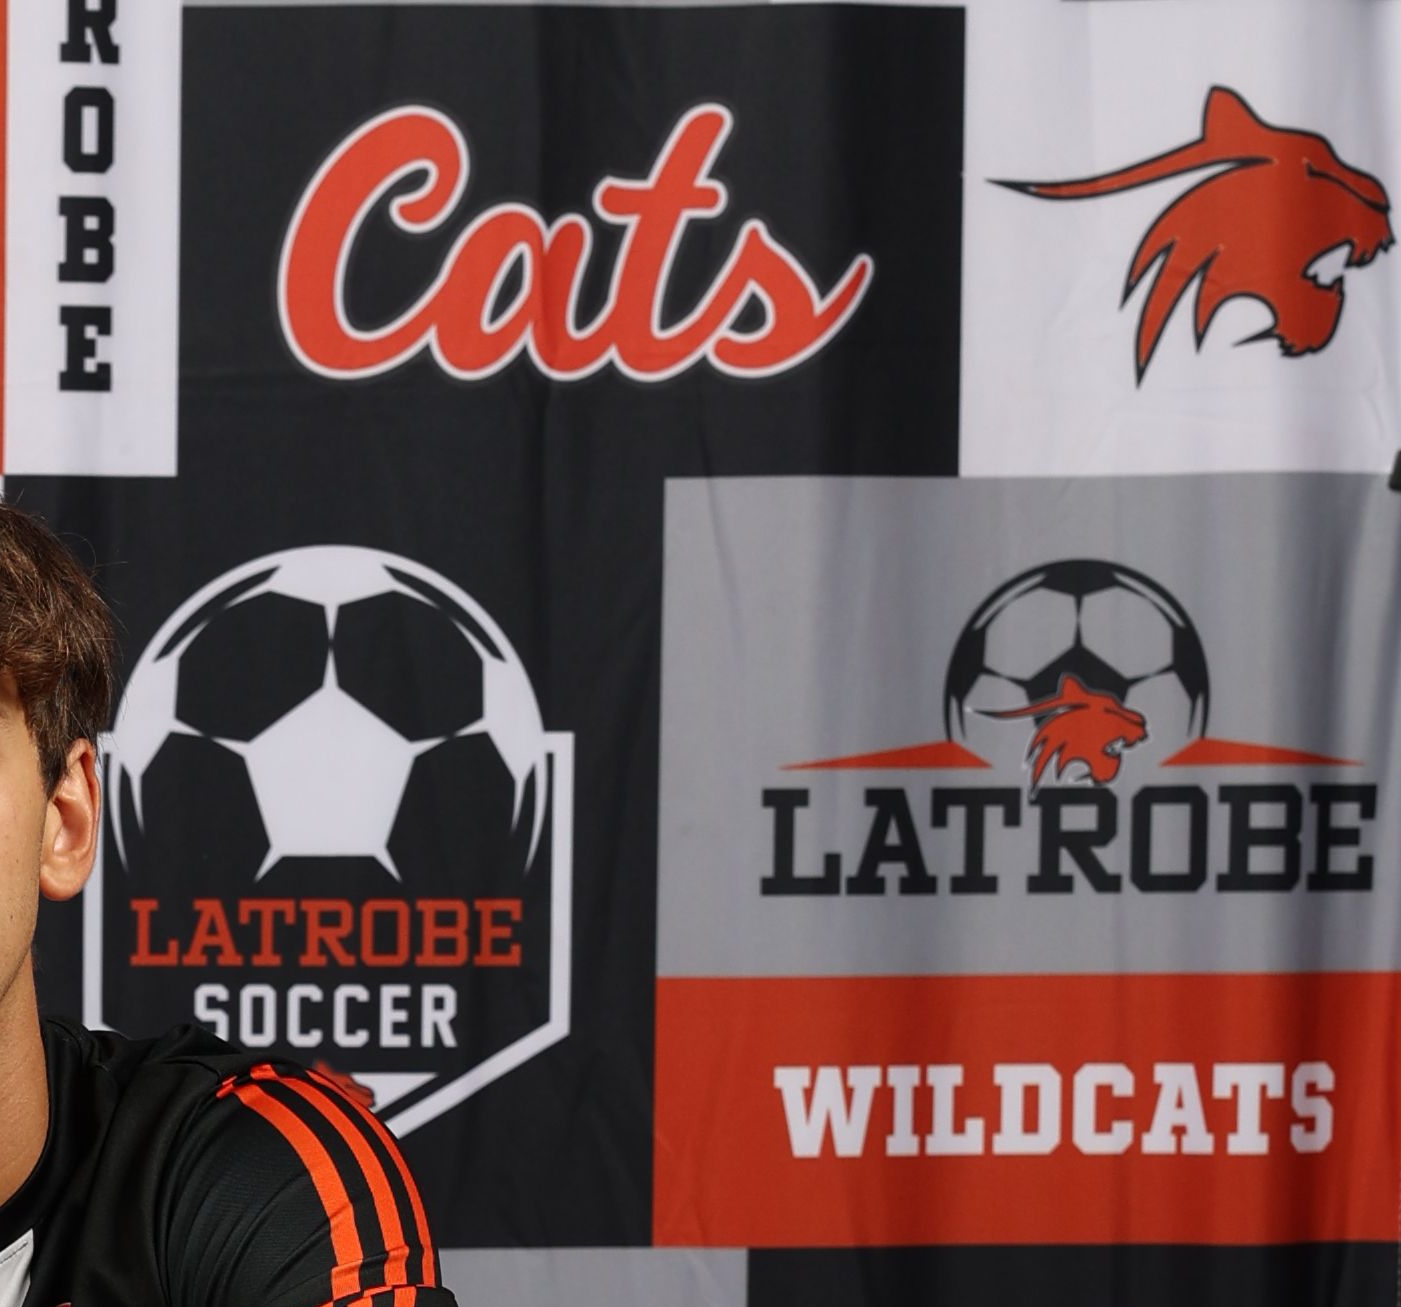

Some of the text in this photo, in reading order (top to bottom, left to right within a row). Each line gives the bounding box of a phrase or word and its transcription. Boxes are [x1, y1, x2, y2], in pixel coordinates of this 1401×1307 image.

[58, 0, 120, 392] ROBE
[278, 101, 874, 381] Cats
[760, 783, 1379, 896] LATROBE
[130, 898, 523, 967] LATROBE
[193, 984, 459, 1049] SOCCER
[773, 1061, 1336, 1158] WILDCATS
